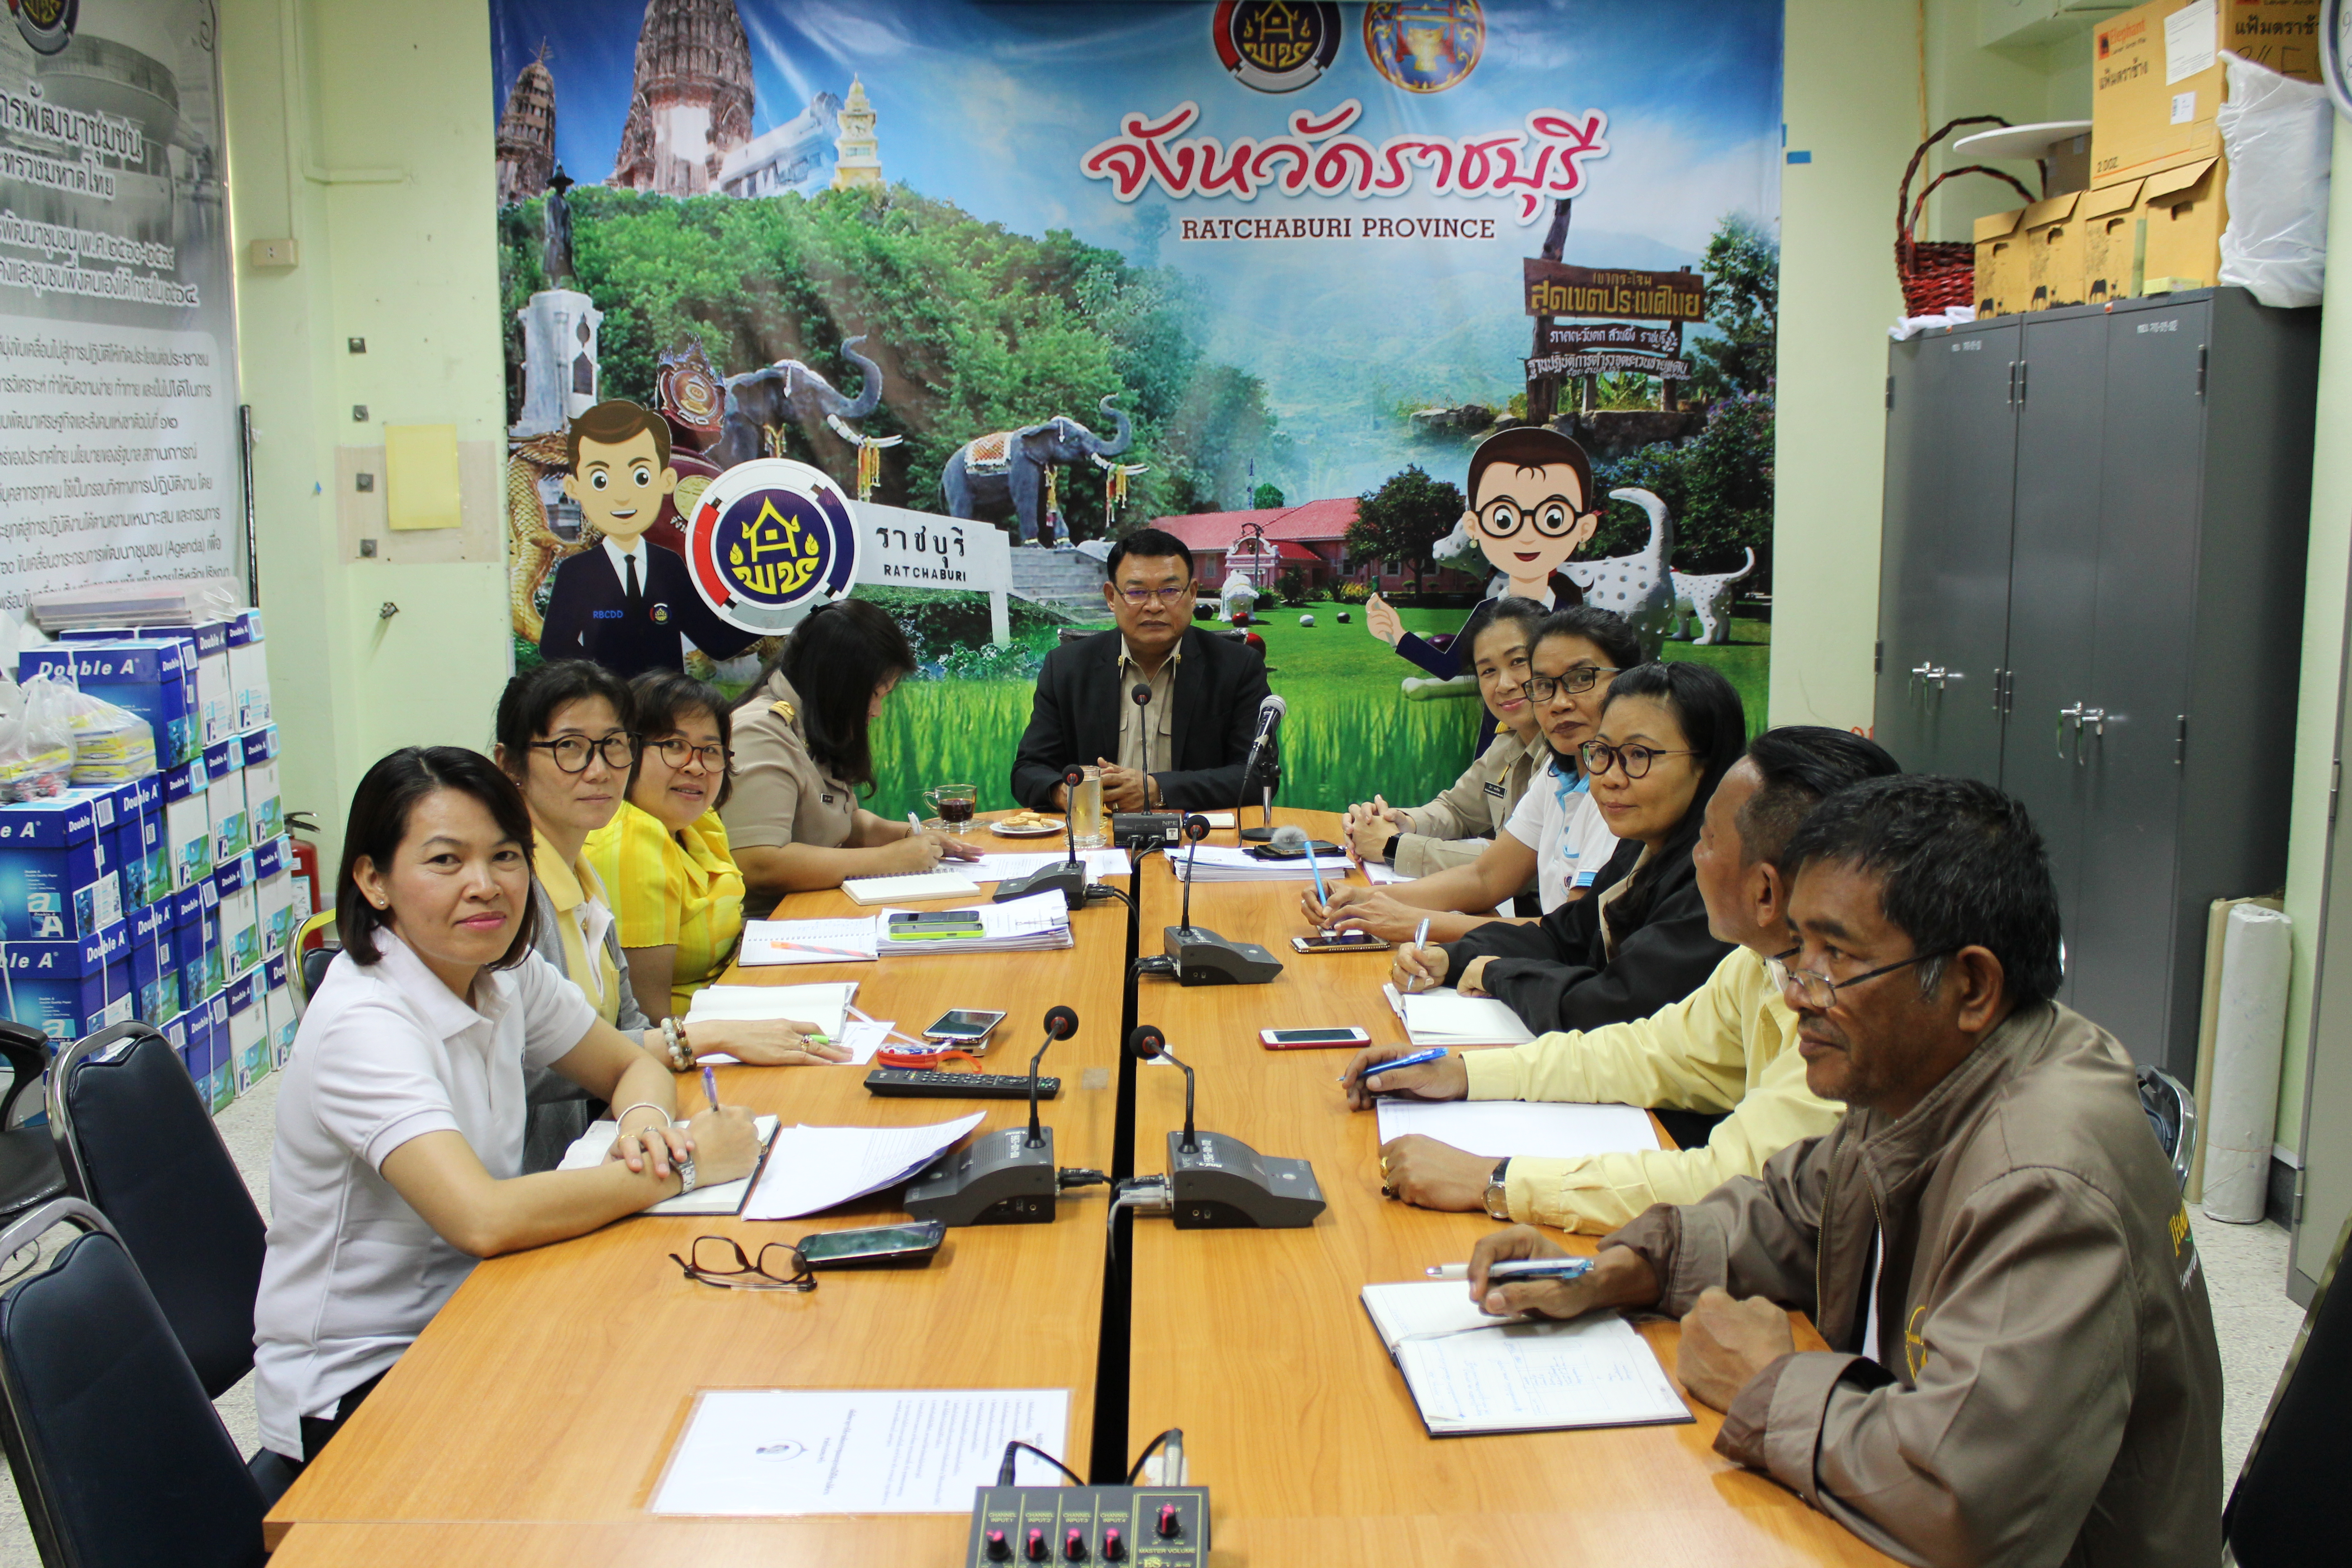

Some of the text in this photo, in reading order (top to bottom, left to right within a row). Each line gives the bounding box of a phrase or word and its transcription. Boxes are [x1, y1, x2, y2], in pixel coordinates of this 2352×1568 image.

[2109, 17, 2146, 45] Elephant
[2235, 14, 2319, 35] แฟ้มตราช้
[2099, 56, 2148, 90] แฟ้มตราช้าง
[1089, 107, 1600, 217] จังหวัดราชบุรี
[1182, 219, 1495, 240] RATCHABURI PROVINCE
[1593, 270, 1651, 286] เขากระโจม
[1531, 280, 1700, 317] สุดเขตประเทศไทย
[160, 417, 178, 429] ๑๒
[165, 537, 205, 558] (Agenda)
[876, 525, 964, 568] ราชบุรี
[884, 564, 966, 582] RATCHABURI
[593, 610, 623, 618] RBCDD
[230, 625, 248, 637] Double A
[200, 631, 225, 650] Double A
[38, 659, 135, 676] Double A
[162, 658, 180, 672] Double
[248, 744, 262, 755] Double
[209, 753, 227, 767] Double A
[170, 777, 185, 790] Double
[124, 785, 158, 811] Double A
[20, 822, 35, 838] A
[69, 816, 90, 833] Double
[260, 854, 274, 867] Double
[222, 870, 240, 887] Double A
[164, 906, 170, 921] A
[181, 898, 198, 915] Double
[87, 930, 125, 963] Double A
[38, 952, 53, 968] A
[273, 966, 285, 980] Dou
[232, 986, 250, 1004] Double A
[191, 1017, 209, 1034] Double
